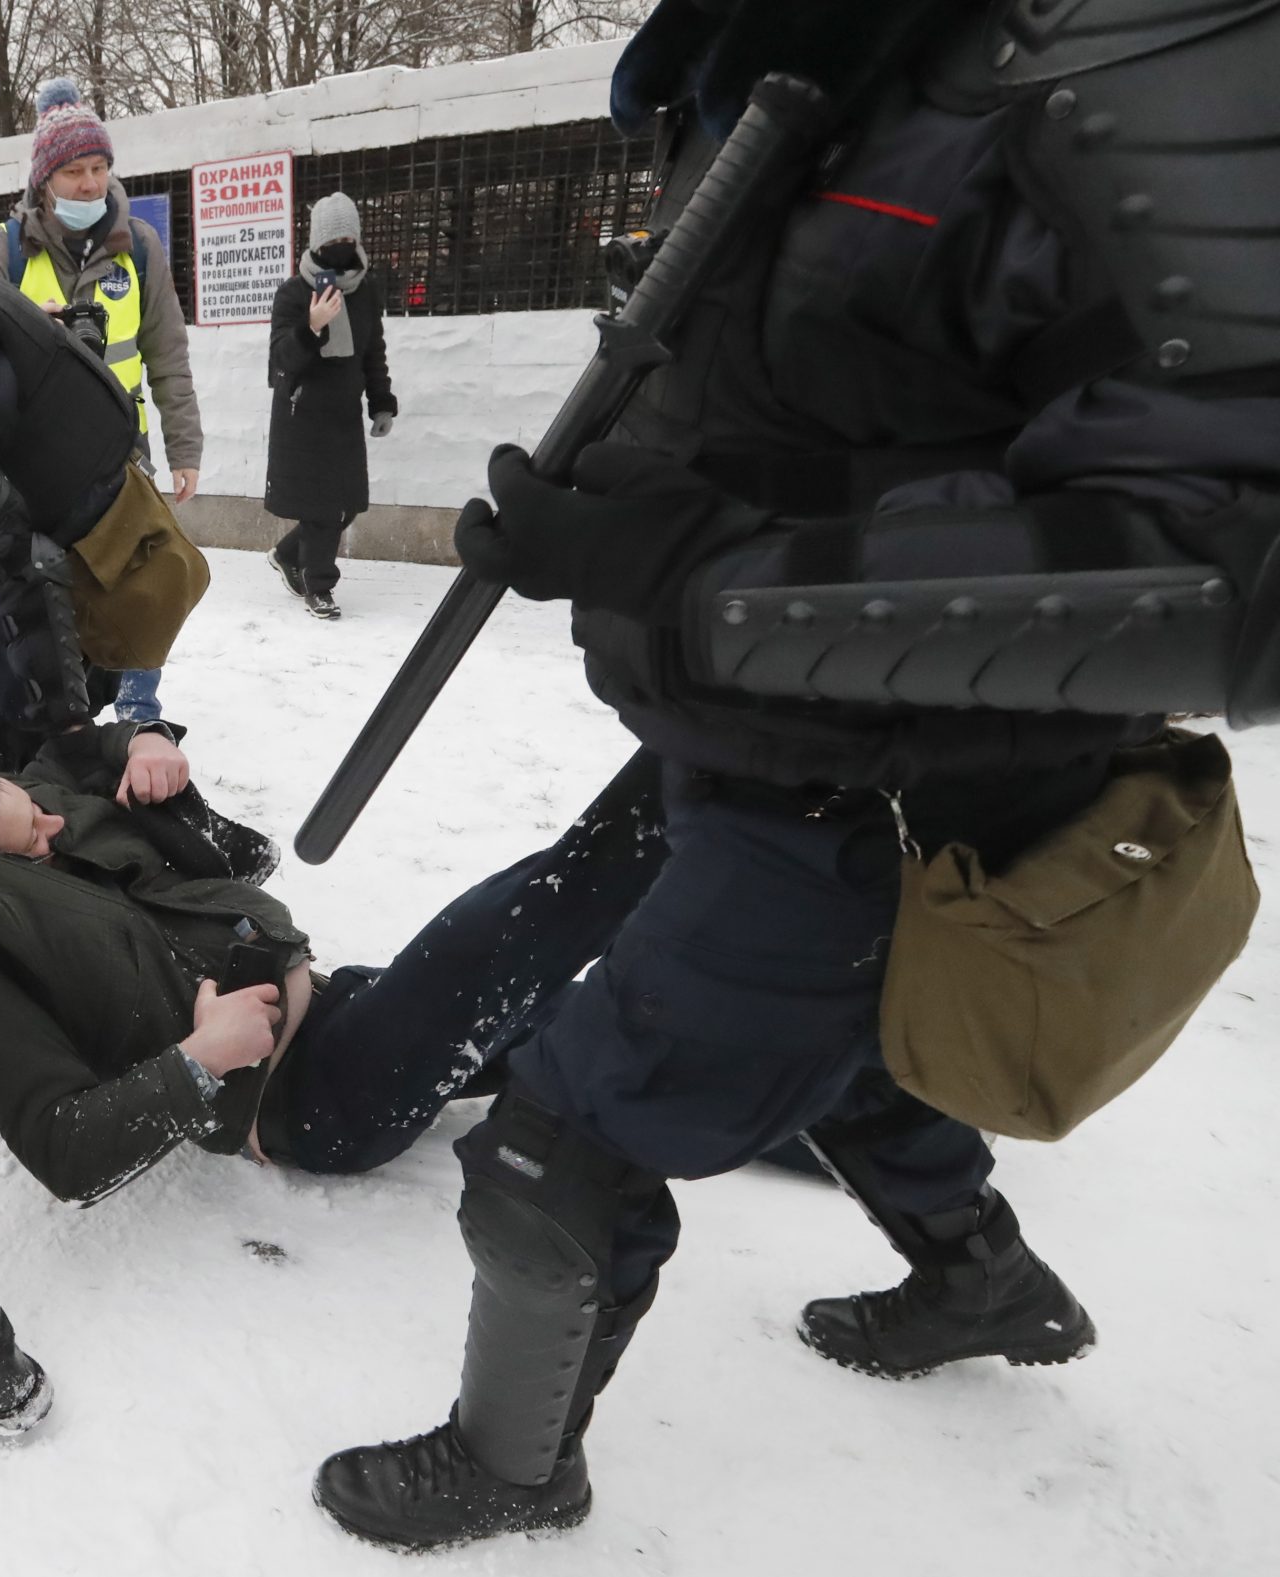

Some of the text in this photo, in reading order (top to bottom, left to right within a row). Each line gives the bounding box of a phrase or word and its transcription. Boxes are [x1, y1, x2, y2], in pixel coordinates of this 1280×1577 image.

[199, 160, 284, 186] ОХРАННАЯ
[200, 179, 284, 203] ЗОНА
[200, 198, 284, 221] МЕТРОПОЛИТЕНА
[207, 234, 236, 246] РАДИУСЕ
[239, 228, 255, 243] 25
[257, 229, 285, 240] МЕТРОВ
[201, 245, 285, 267] НЕ ДОПУСКАЕТСЯ
[202, 263, 285, 280] ПРОВЕДЕНИЕ РАБОТ
[100, 281, 130, 292] PRESS
[208, 280, 250, 292] РАЗМЕЩЕНИЕ
[202, 292, 274, 306] БЕЗ СОГЛАСОВАН
[202, 305, 272, 319] С МЕТРОПОЛИТЕН
